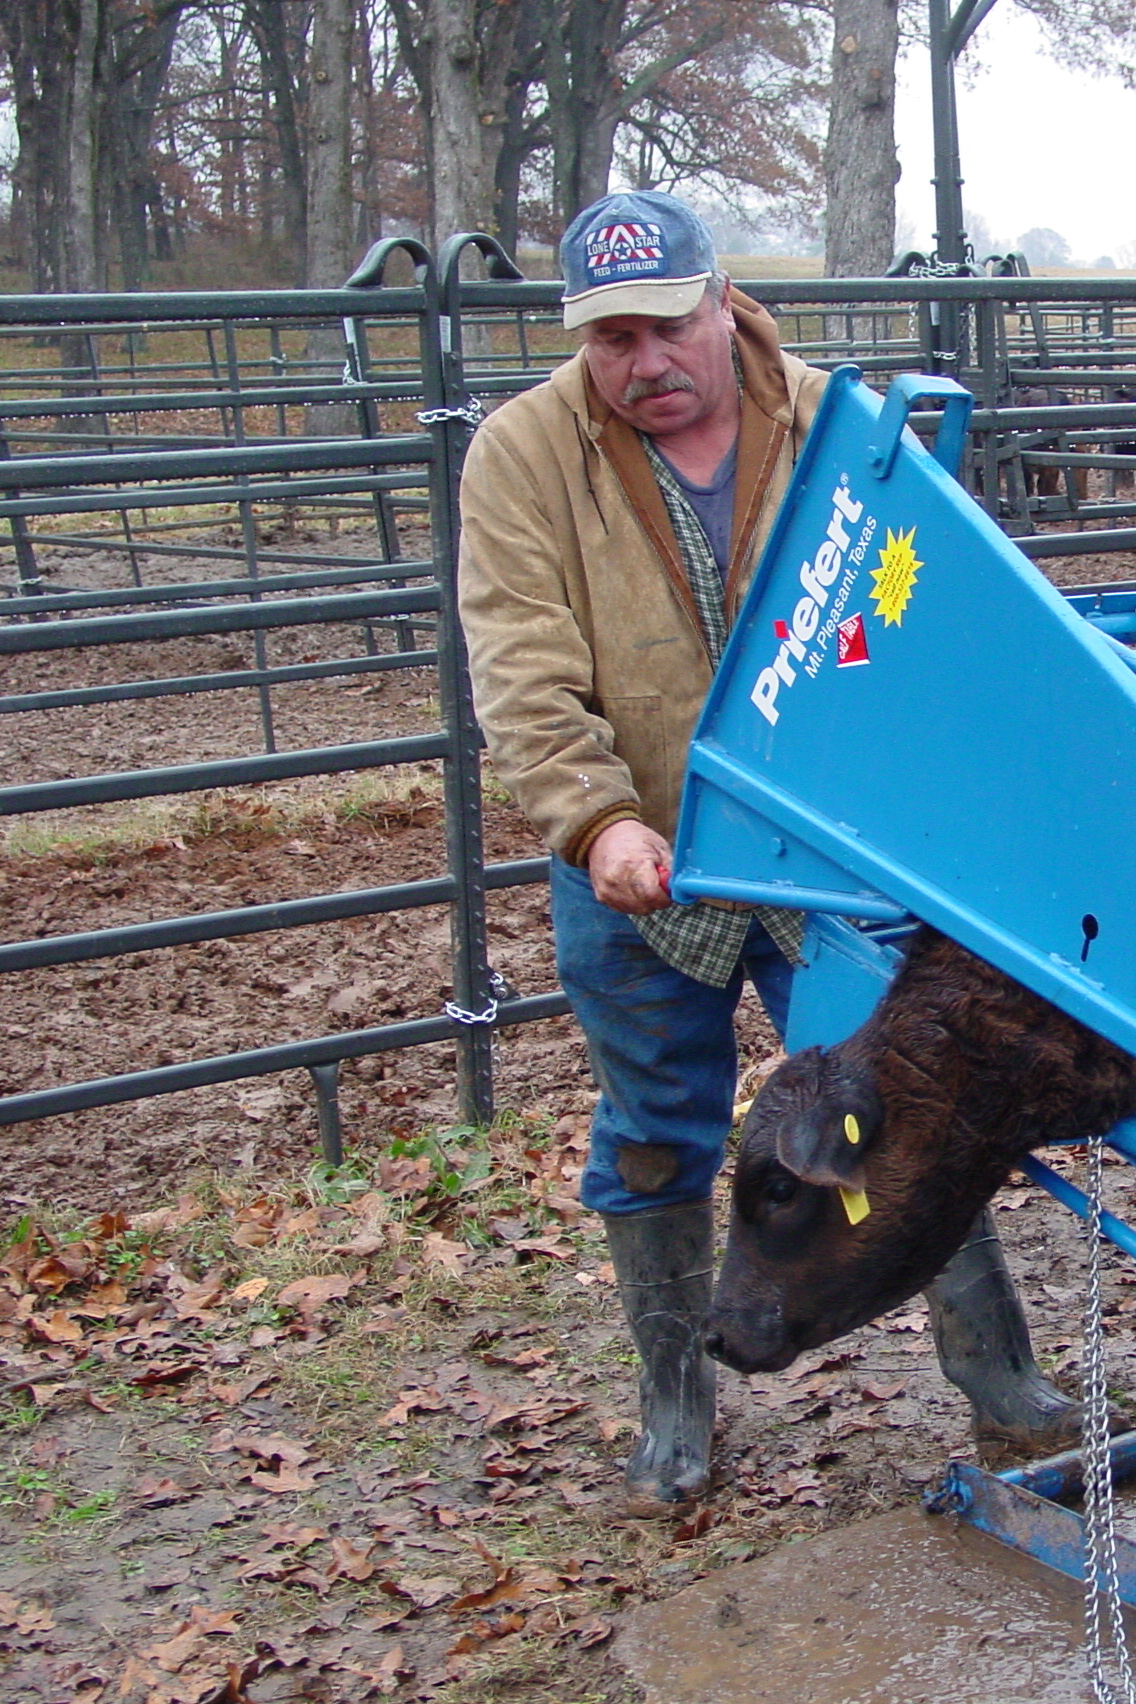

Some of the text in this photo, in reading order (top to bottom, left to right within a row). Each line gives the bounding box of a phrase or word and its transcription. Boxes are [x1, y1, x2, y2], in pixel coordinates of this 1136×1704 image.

[588, 236, 660, 256] LONE STAR
[594, 267, 610, 277] FEED
[617, 261, 658, 273] FERTILIZER
[750, 486, 864, 727] Priefert
[804, 516, 877, 679] Mt. Pleasant, Texas
